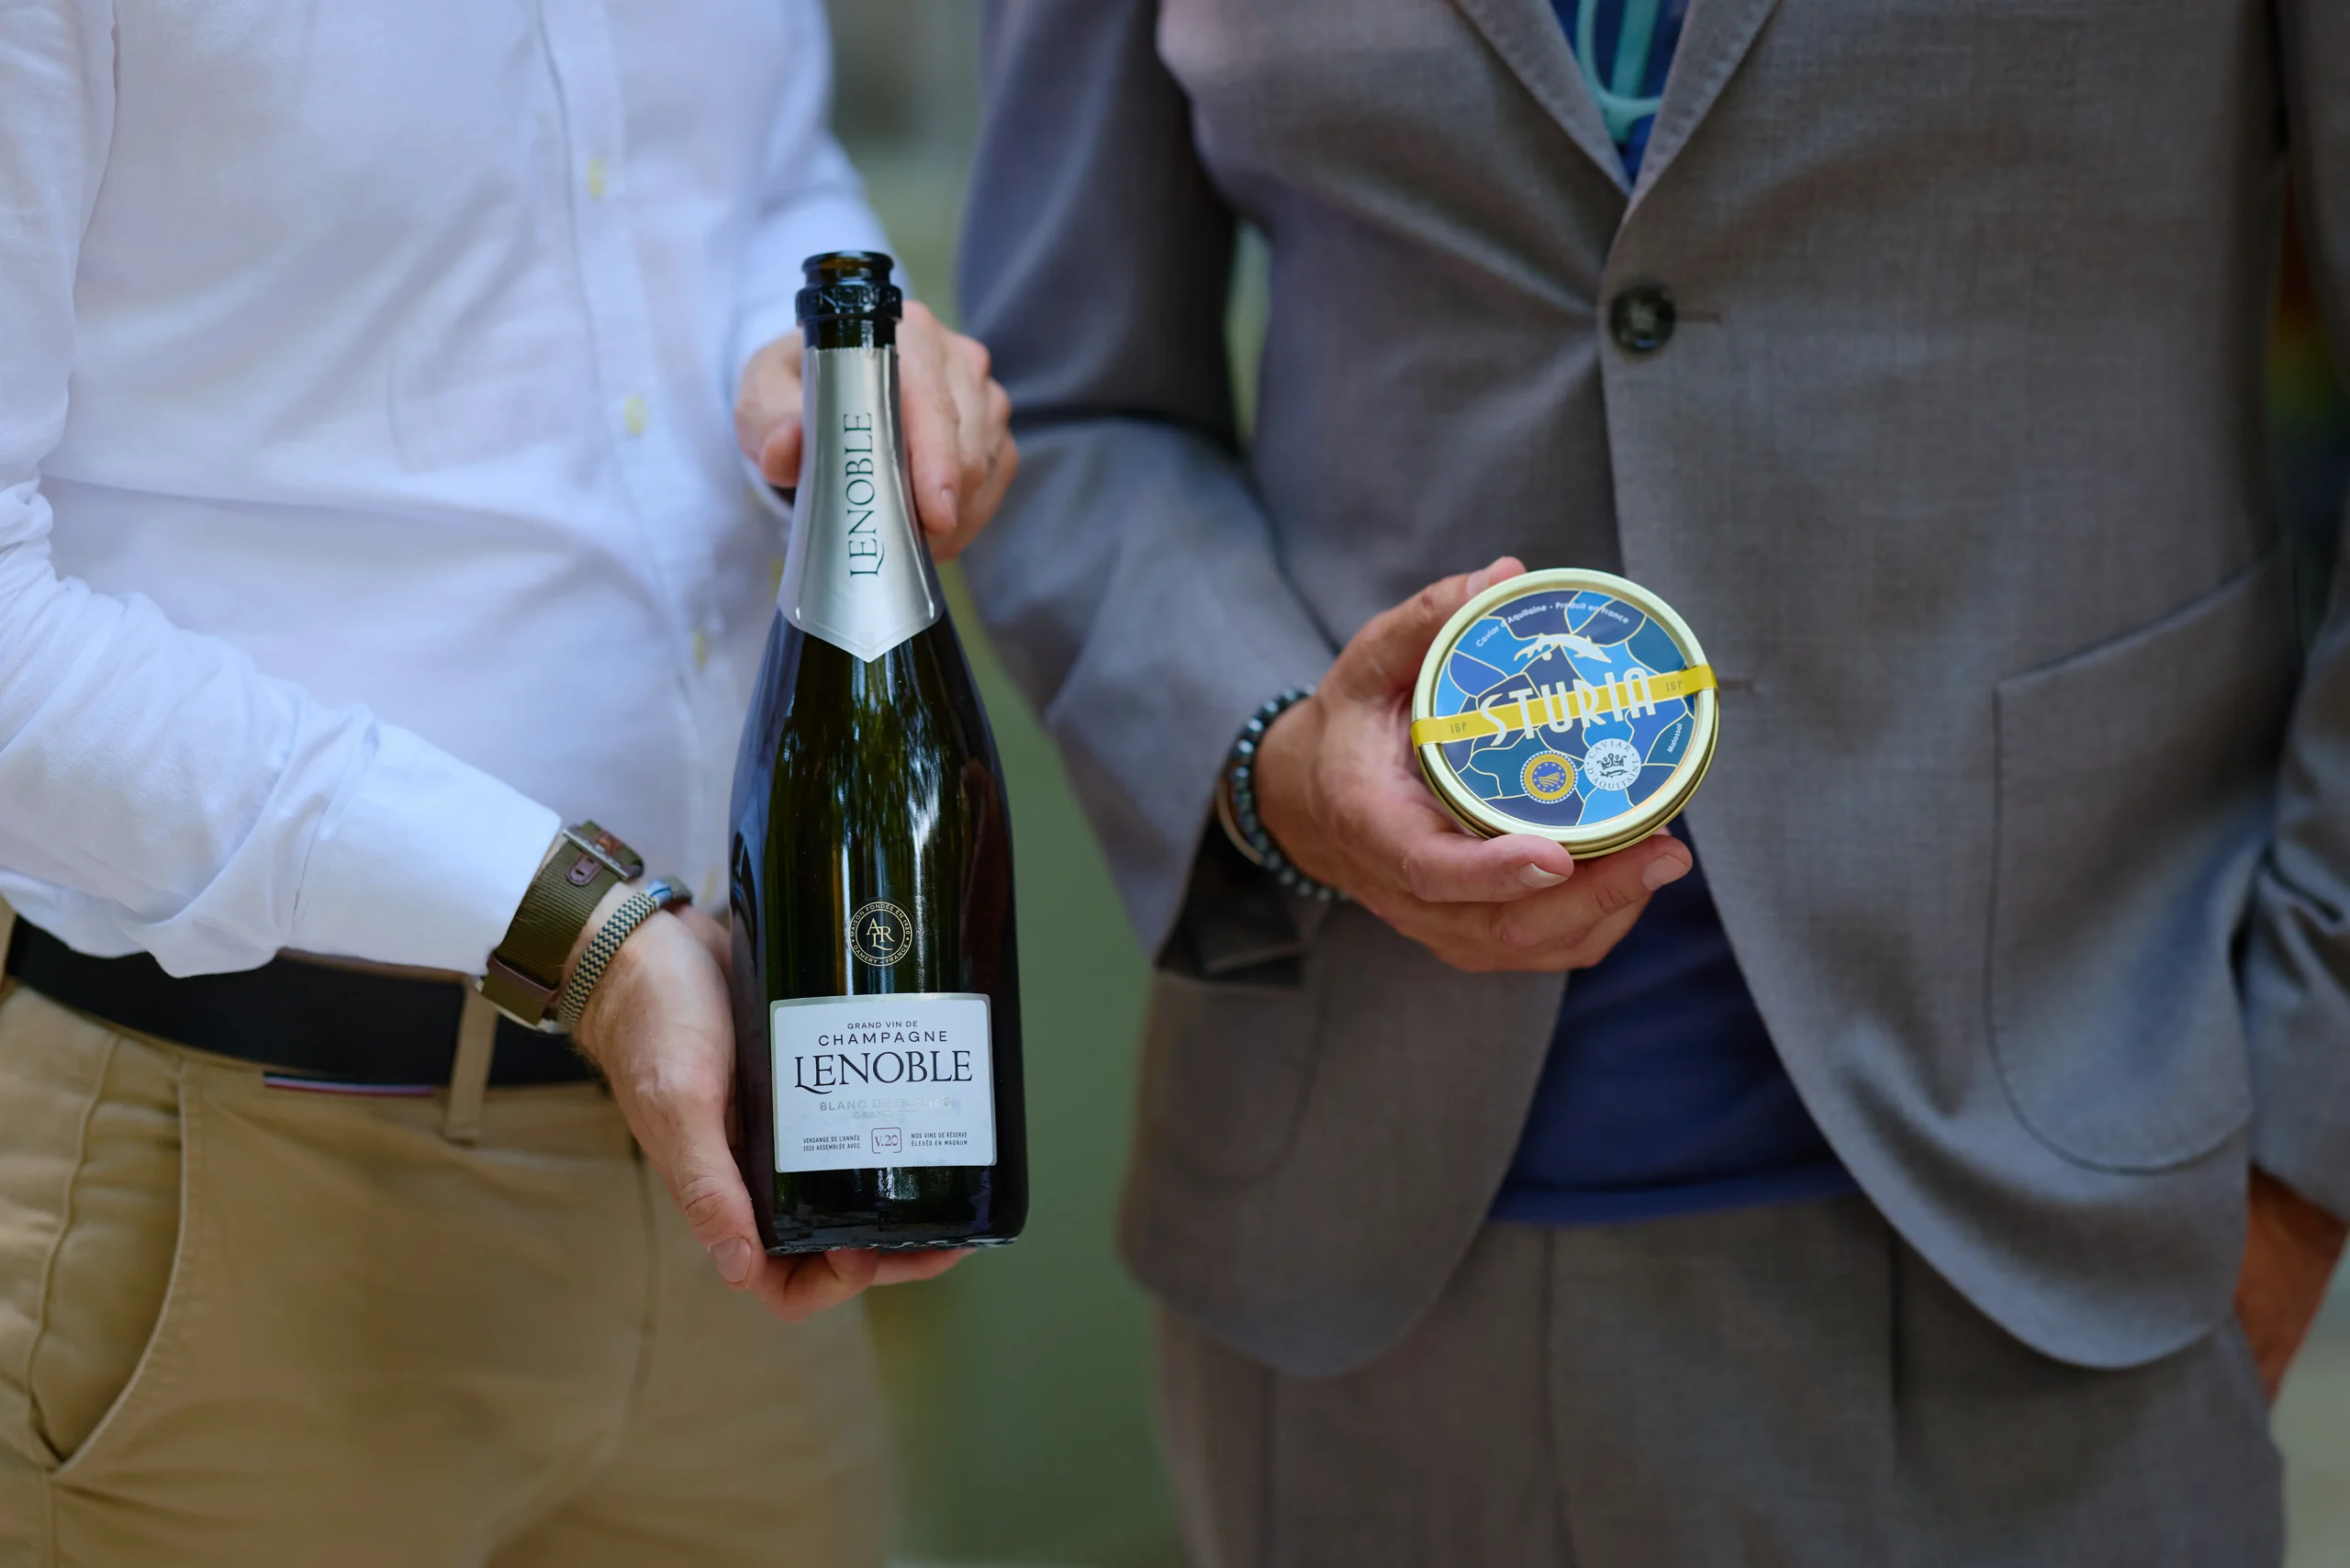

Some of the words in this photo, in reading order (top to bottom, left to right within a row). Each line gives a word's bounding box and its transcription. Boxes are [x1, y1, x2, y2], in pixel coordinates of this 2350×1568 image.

[844, 412, 885, 577] LENOBLE
[1476, 625, 1499, 647] Caviar
[1555, 601, 1586, 610] Produit
[1600, 607, 1629, 624] France
[1665, 680, 1683, 692] IGP
[1480, 666, 1656, 746] STURIA
[1450, 722, 1467, 734] IGP
[1667, 722, 1683, 754] Malossol
[1588, 740, 1631, 758] CAVIAR
[850, 911, 865, 937] MAISON
[895, 909, 904, 919] EN
[902, 919, 911, 935] 1920
[853, 946, 878, 964] DAMERY
[885, 944, 909, 964] FRANCE
[847, 1021, 882, 1029] GRAND
[818, 1030, 948, 1047] CHAMPAGNE
[794, 1050, 973, 1095] LENOBLE
[820, 1100, 867, 1112] BLANC
[872, 1099, 890, 1109] DE
[852, 1110, 892, 1119] GRAND
[816, 1143, 845, 1151] ASSEMBLÉE
[874, 1135, 899, 1147] V.20
